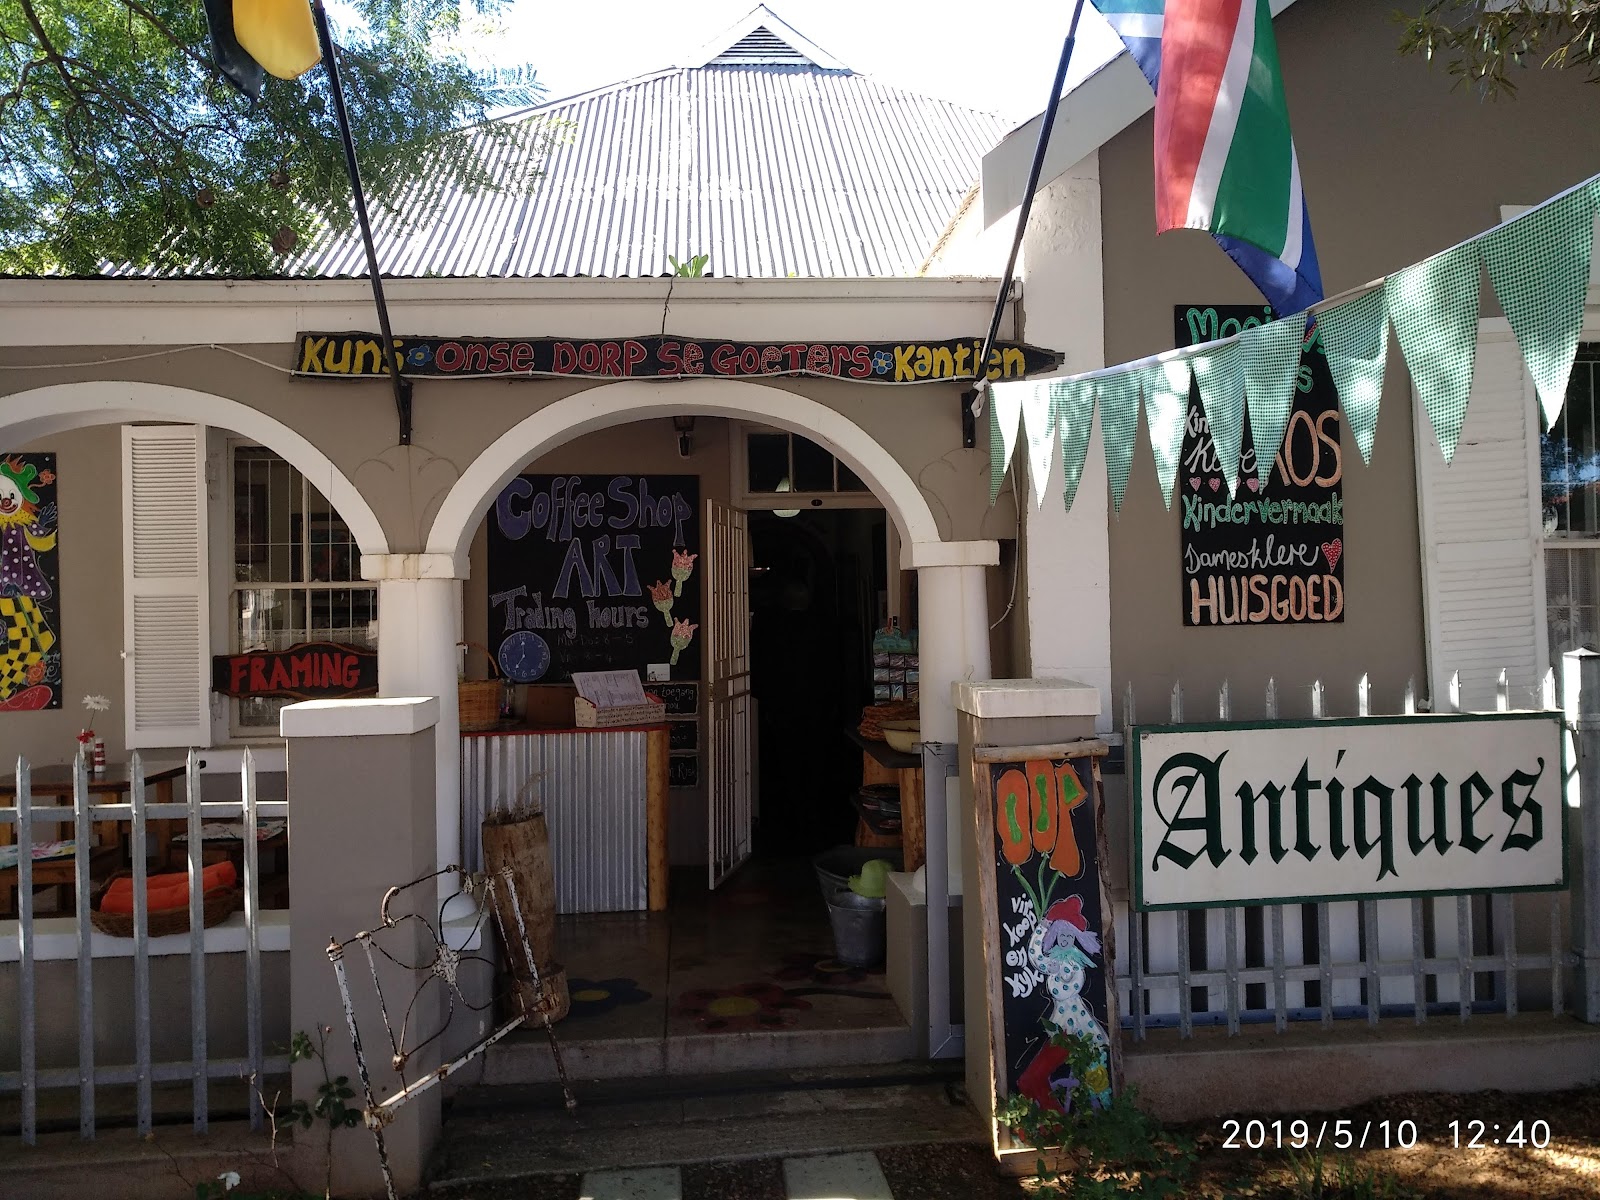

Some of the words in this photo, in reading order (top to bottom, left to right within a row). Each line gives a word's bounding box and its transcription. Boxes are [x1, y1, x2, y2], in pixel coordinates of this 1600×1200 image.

[552, 341, 647, 377] DORP
[496, 476, 605, 542] Coffee
[608, 476, 692, 547] Shop
[552, 534, 642, 599] ART
[489, 585, 577, 639] Trading
[586, 600, 649, 629] hours
[1190, 574, 1343, 625] HUISGOED
[229, 652, 361, 692] FRAMING
[1152, 749, 1546, 883] Antiques
[1006, 946, 1028, 968] en
